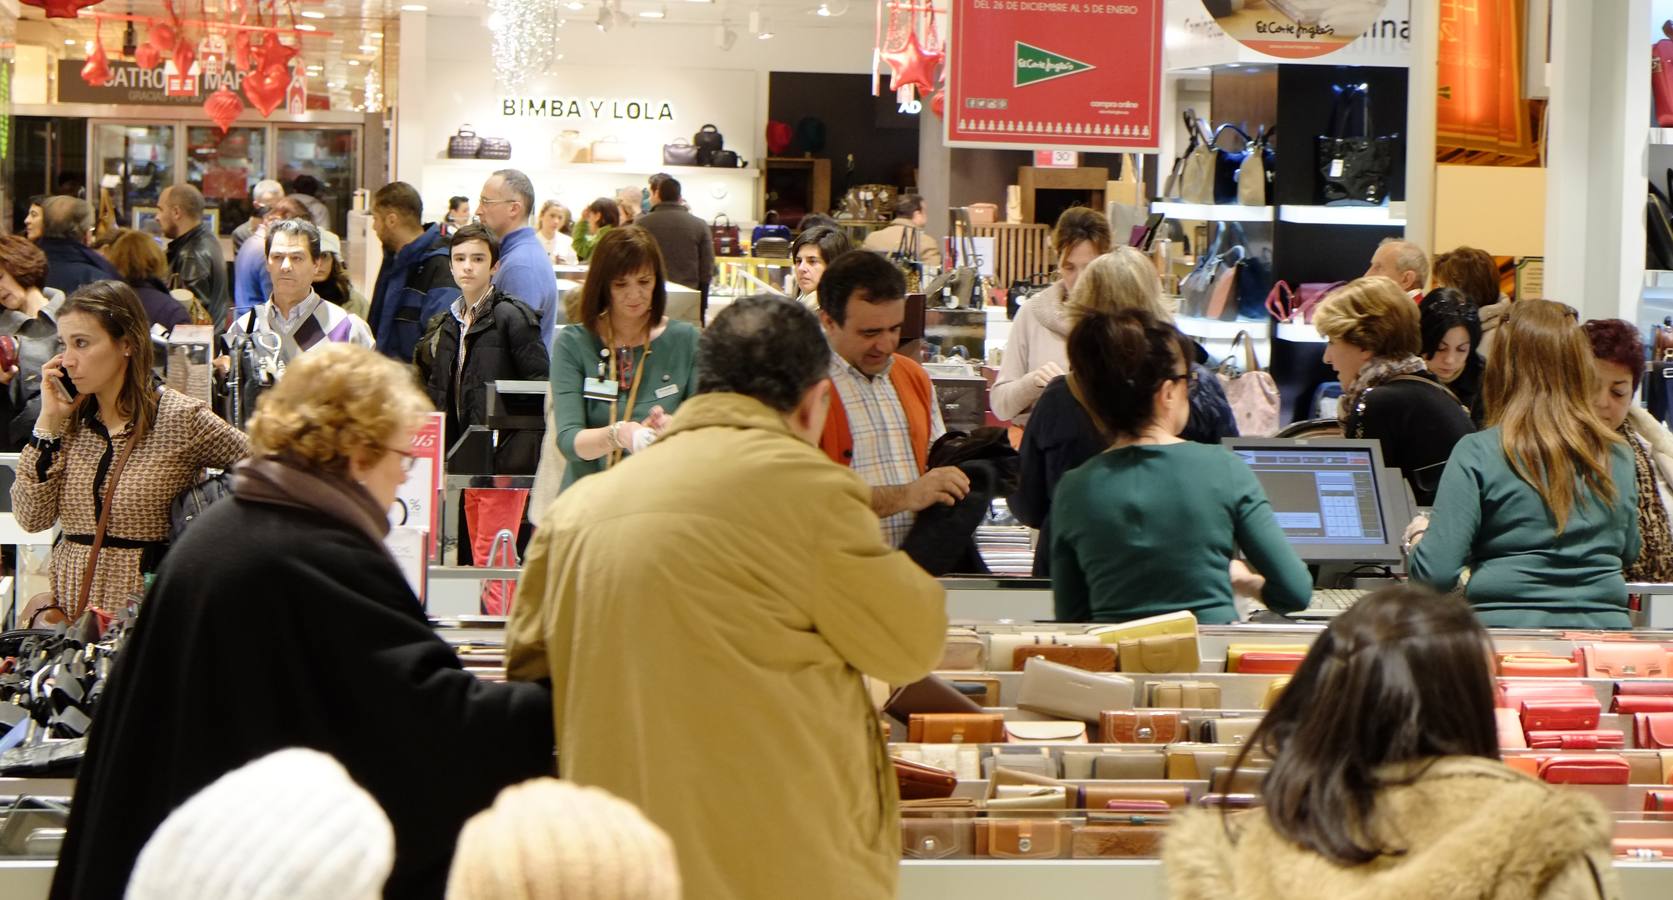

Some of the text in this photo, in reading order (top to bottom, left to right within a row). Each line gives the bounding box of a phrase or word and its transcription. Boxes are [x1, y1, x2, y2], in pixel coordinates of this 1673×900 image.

[974, 0, 1138, 14] DEL 26 DE DICIEMBRE AL 5 DE ENERO
[503, 98, 673, 120] BIMBA Y LOLA
